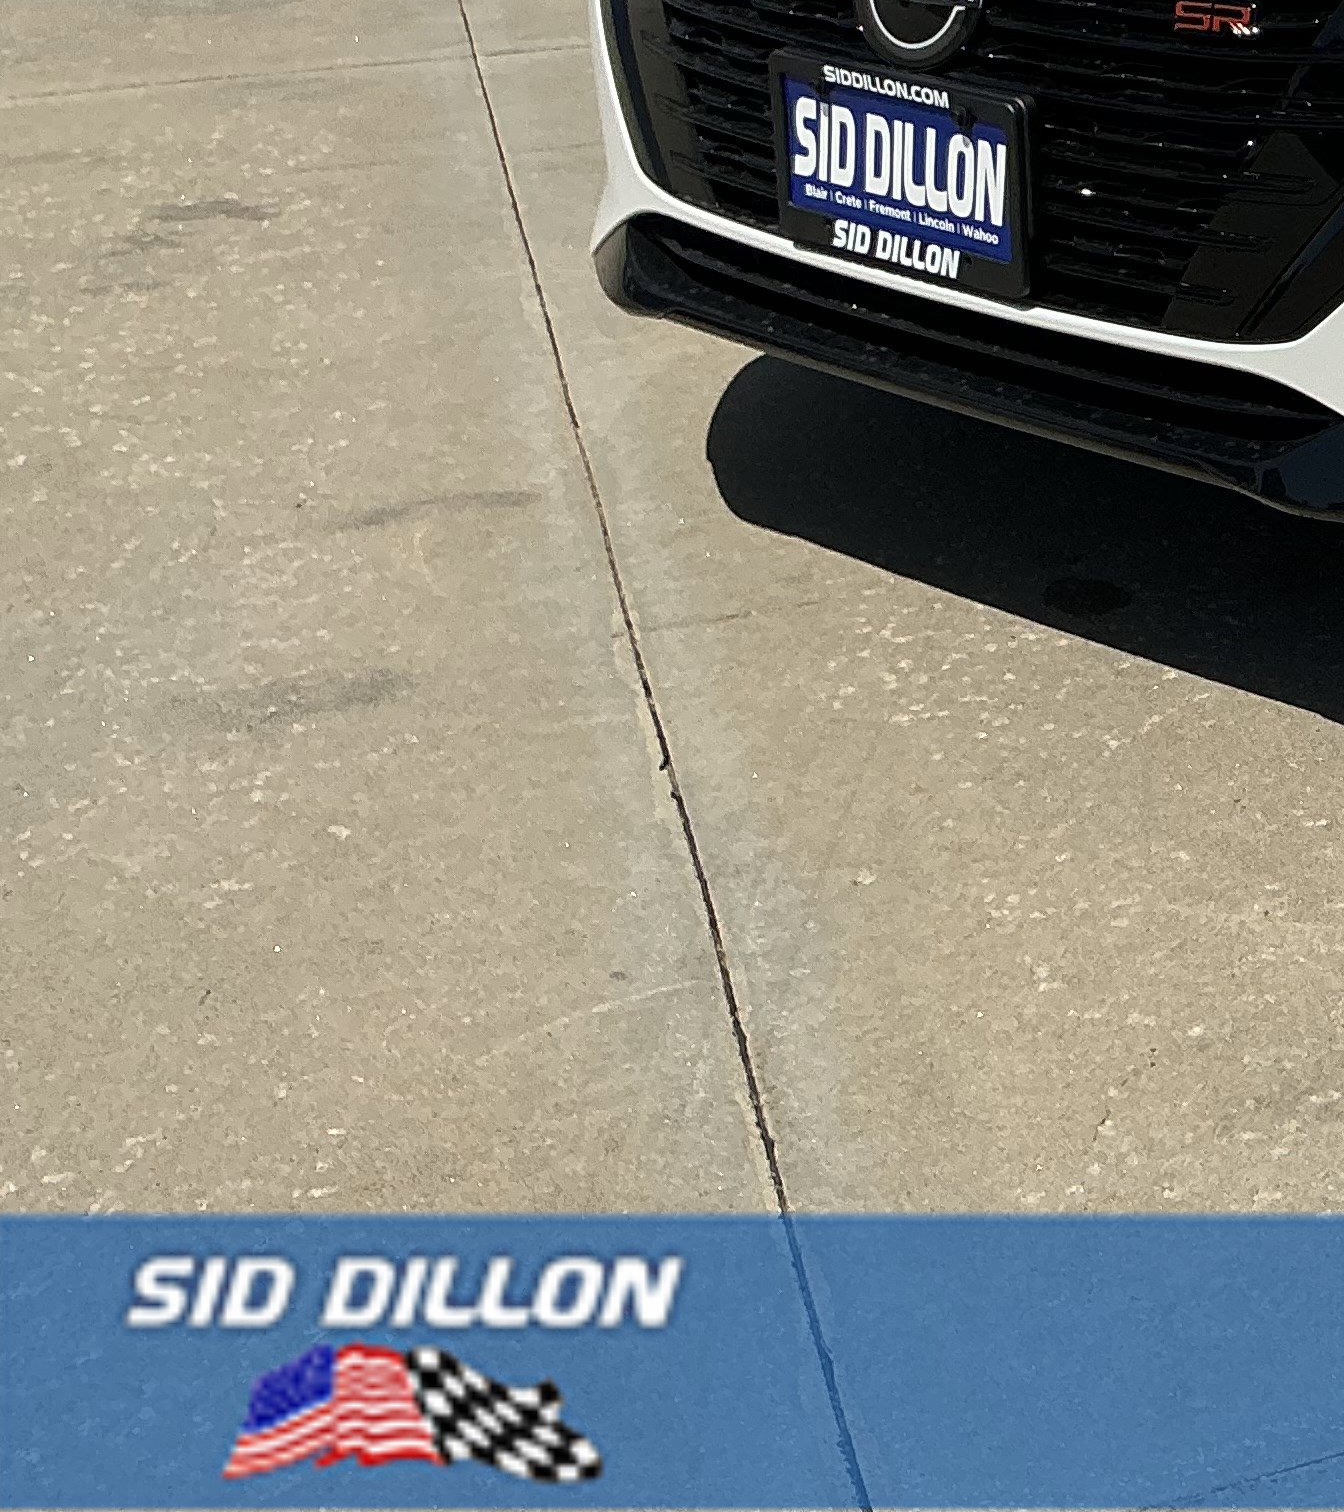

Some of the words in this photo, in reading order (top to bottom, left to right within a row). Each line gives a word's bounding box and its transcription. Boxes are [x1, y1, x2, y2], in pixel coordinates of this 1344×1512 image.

[1174, 0, 1252, 36] SR
[823, 64, 950, 109] SIDDILLON.COM
[794, 96, 856, 188] SID
[864, 112, 1007, 227] DILLON
[805, 183, 828, 201] Blair
[835, 191, 862, 210] Crete
[869, 199, 912, 222] Fremont
[918, 211, 955, 234] Lincoln
[962, 225, 999, 245] Wahoo
[832, 219, 872, 255] SID
[875, 229, 960, 280] DILLON
